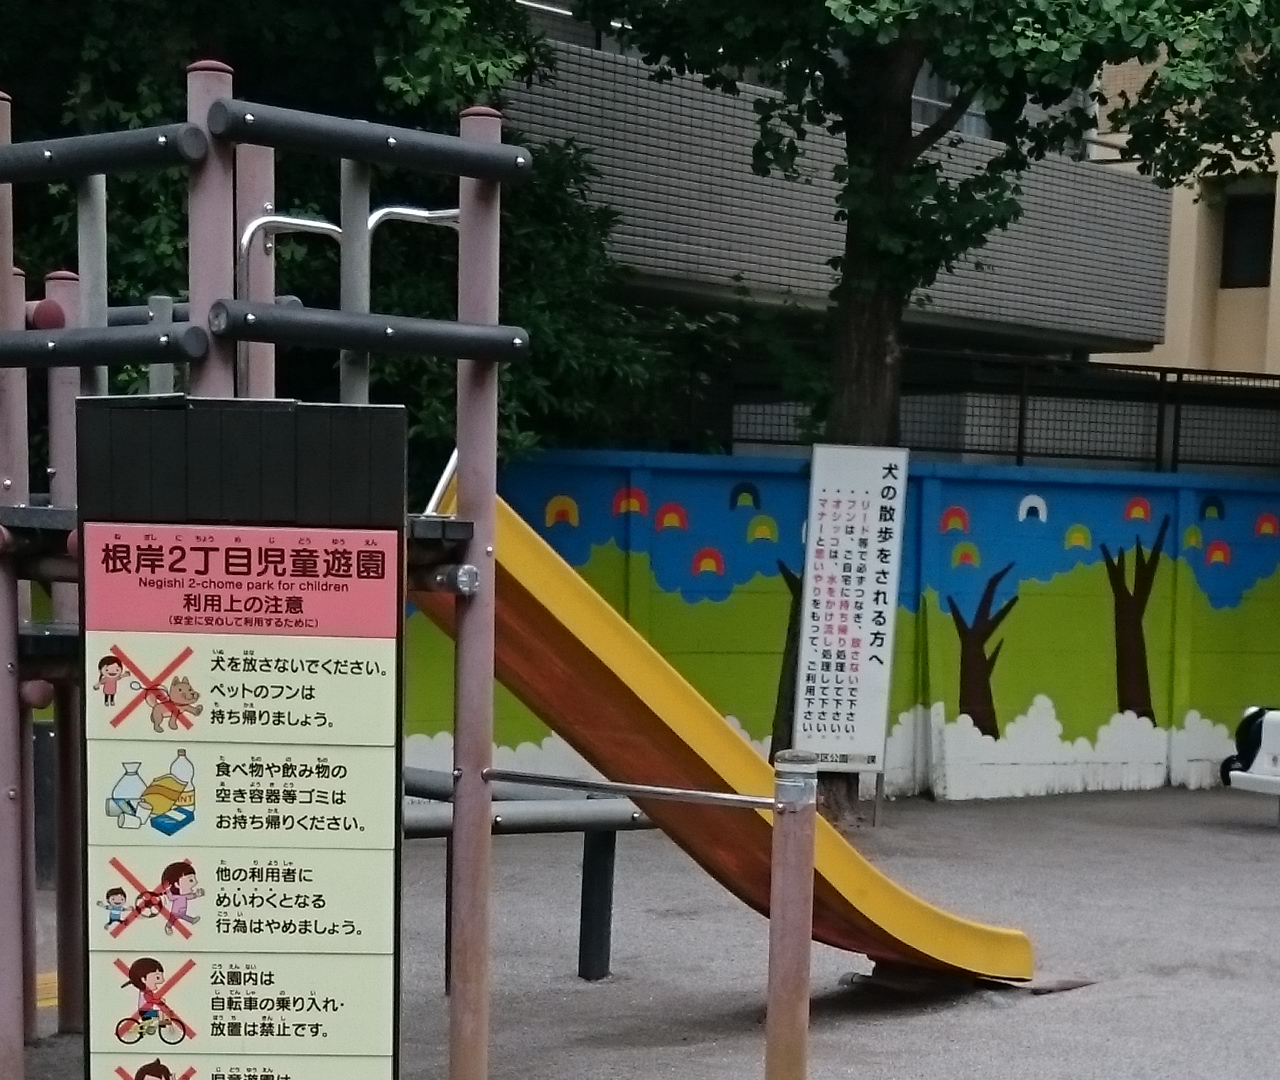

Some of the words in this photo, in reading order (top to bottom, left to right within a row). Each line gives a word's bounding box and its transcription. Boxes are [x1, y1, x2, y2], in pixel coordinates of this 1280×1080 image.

[101, 543, 385, 580] 根岸2丁目児童遊園
[869, 463, 899, 666] 犬の散歩をされる方へ
[139, 577, 184, 589] Negishi
[188, 578, 243, 590] 2-chome
[247, 580, 274, 591] park
[278, 580, 295, 591] for
[299, 581, 349, 592] children
[183, 593, 304, 614] 利用上の注意
[169, 615, 318, 628] (安全に安心して利用するために)
[211, 656, 386, 676] 犬を放さないでください。
[210, 683, 315, 700] ペットのフンは
[211, 709, 333, 728] 持ち帰りましょう。
[216, 762, 347, 779] 食べ物や飲み物の
[216, 788, 346, 805] 空き容器等ゴミは
[216, 814, 365, 831] お持ち帰りください。
[216, 867, 313, 882] 他の利用者に
[216, 893, 326, 909] めいわくとなる
[216, 918, 362, 935] 行為はやめましょう。
[210, 970, 275, 986] 公園内は
[211, 1022, 327, 1037] 放置は禁止です。
